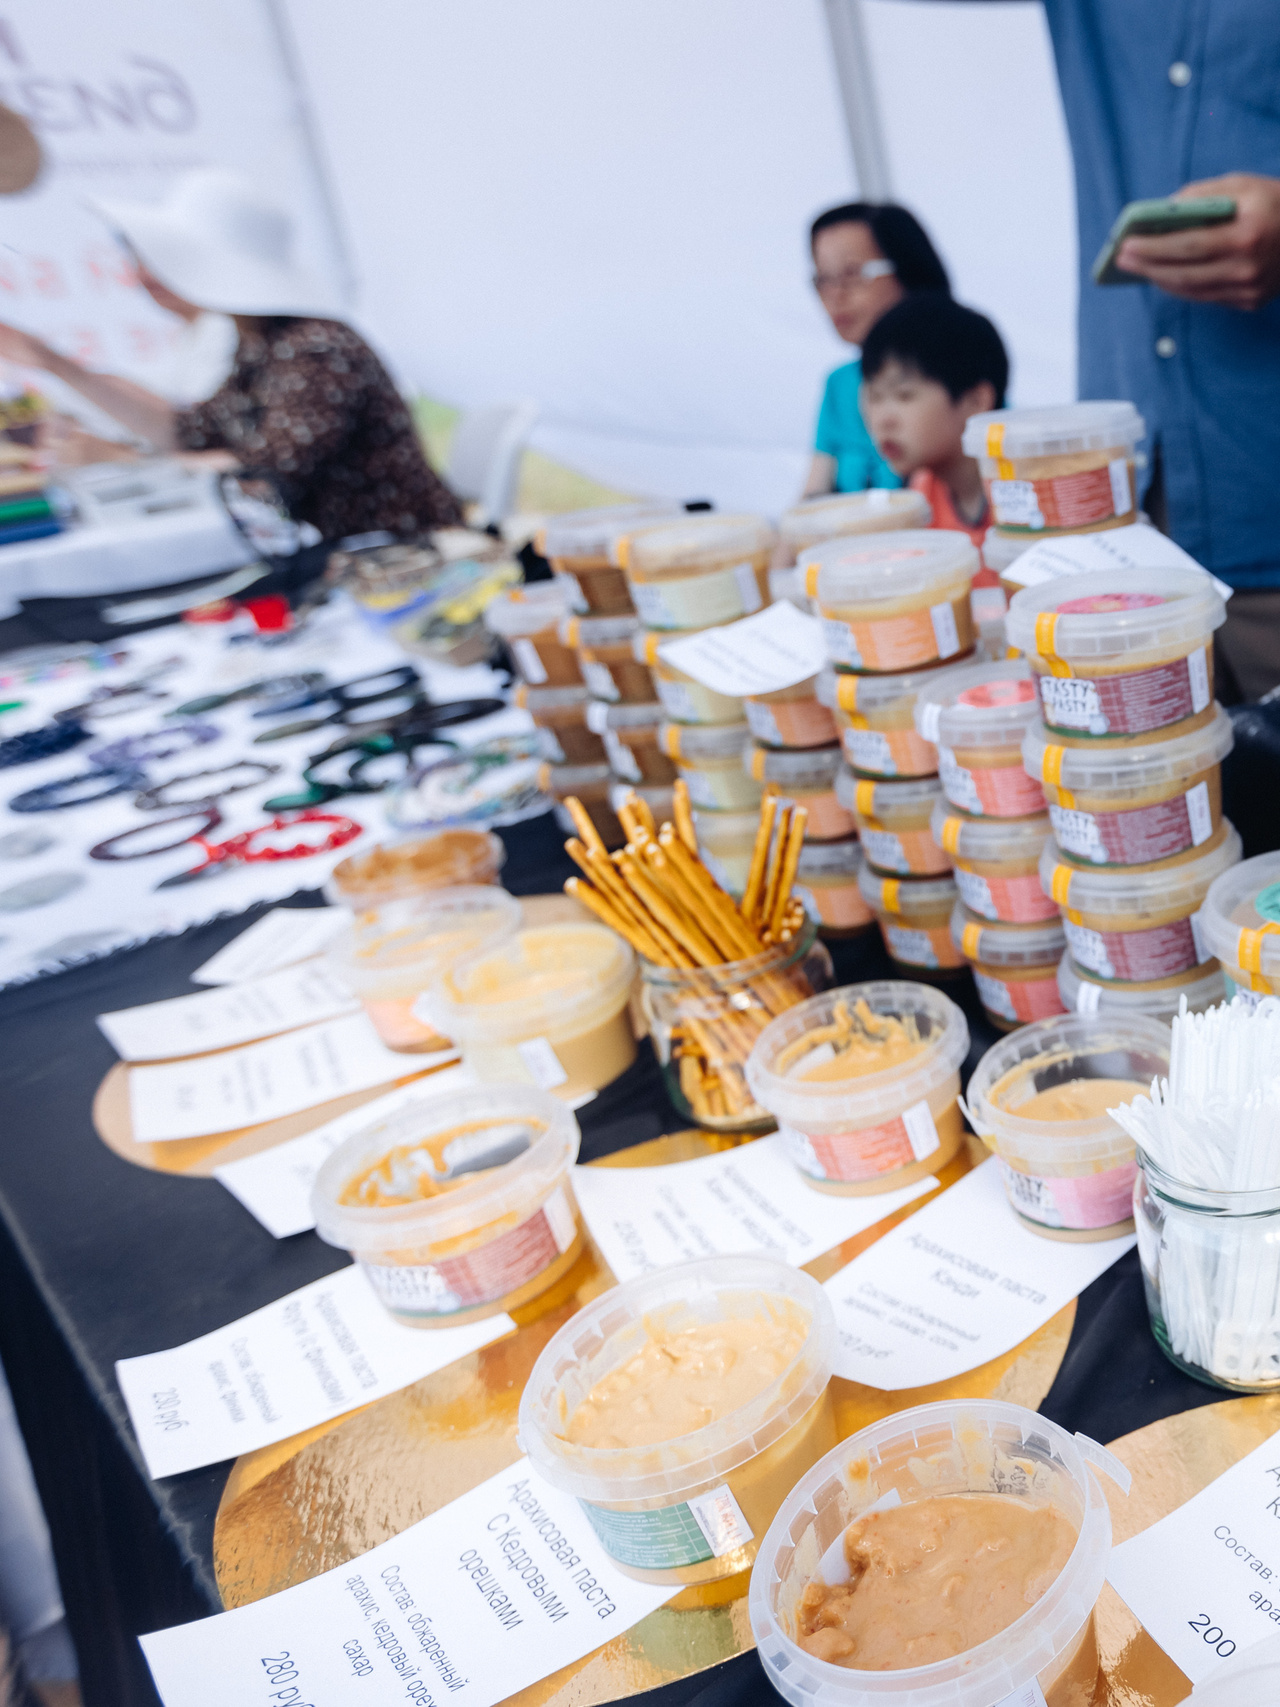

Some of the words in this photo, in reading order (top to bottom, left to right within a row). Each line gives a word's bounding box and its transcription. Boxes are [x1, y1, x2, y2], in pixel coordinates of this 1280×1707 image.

[487, 1513, 510, 1532] С
[508, 1478, 581, 1570] Арахисовая
[572, 1564, 616, 1620] паста
[496, 1529, 569, 1623] Кедровыми
[1213, 1525, 1279, 1585] Состав:
[458, 1549, 524, 1631] орешками
[343, 1638, 374, 1678] сахар
[346, 1574, 380, 1622] арахис,
[371, 1618, 422, 1682] кедровый
[380, 1565, 417, 1615] Состав:
[407, 1611, 471, 1692] обжаренный
[1188, 1613, 1237, 1658] 200
[260, 1651, 299, 1685] 280
[269, 1685, 317, 1707] ру
